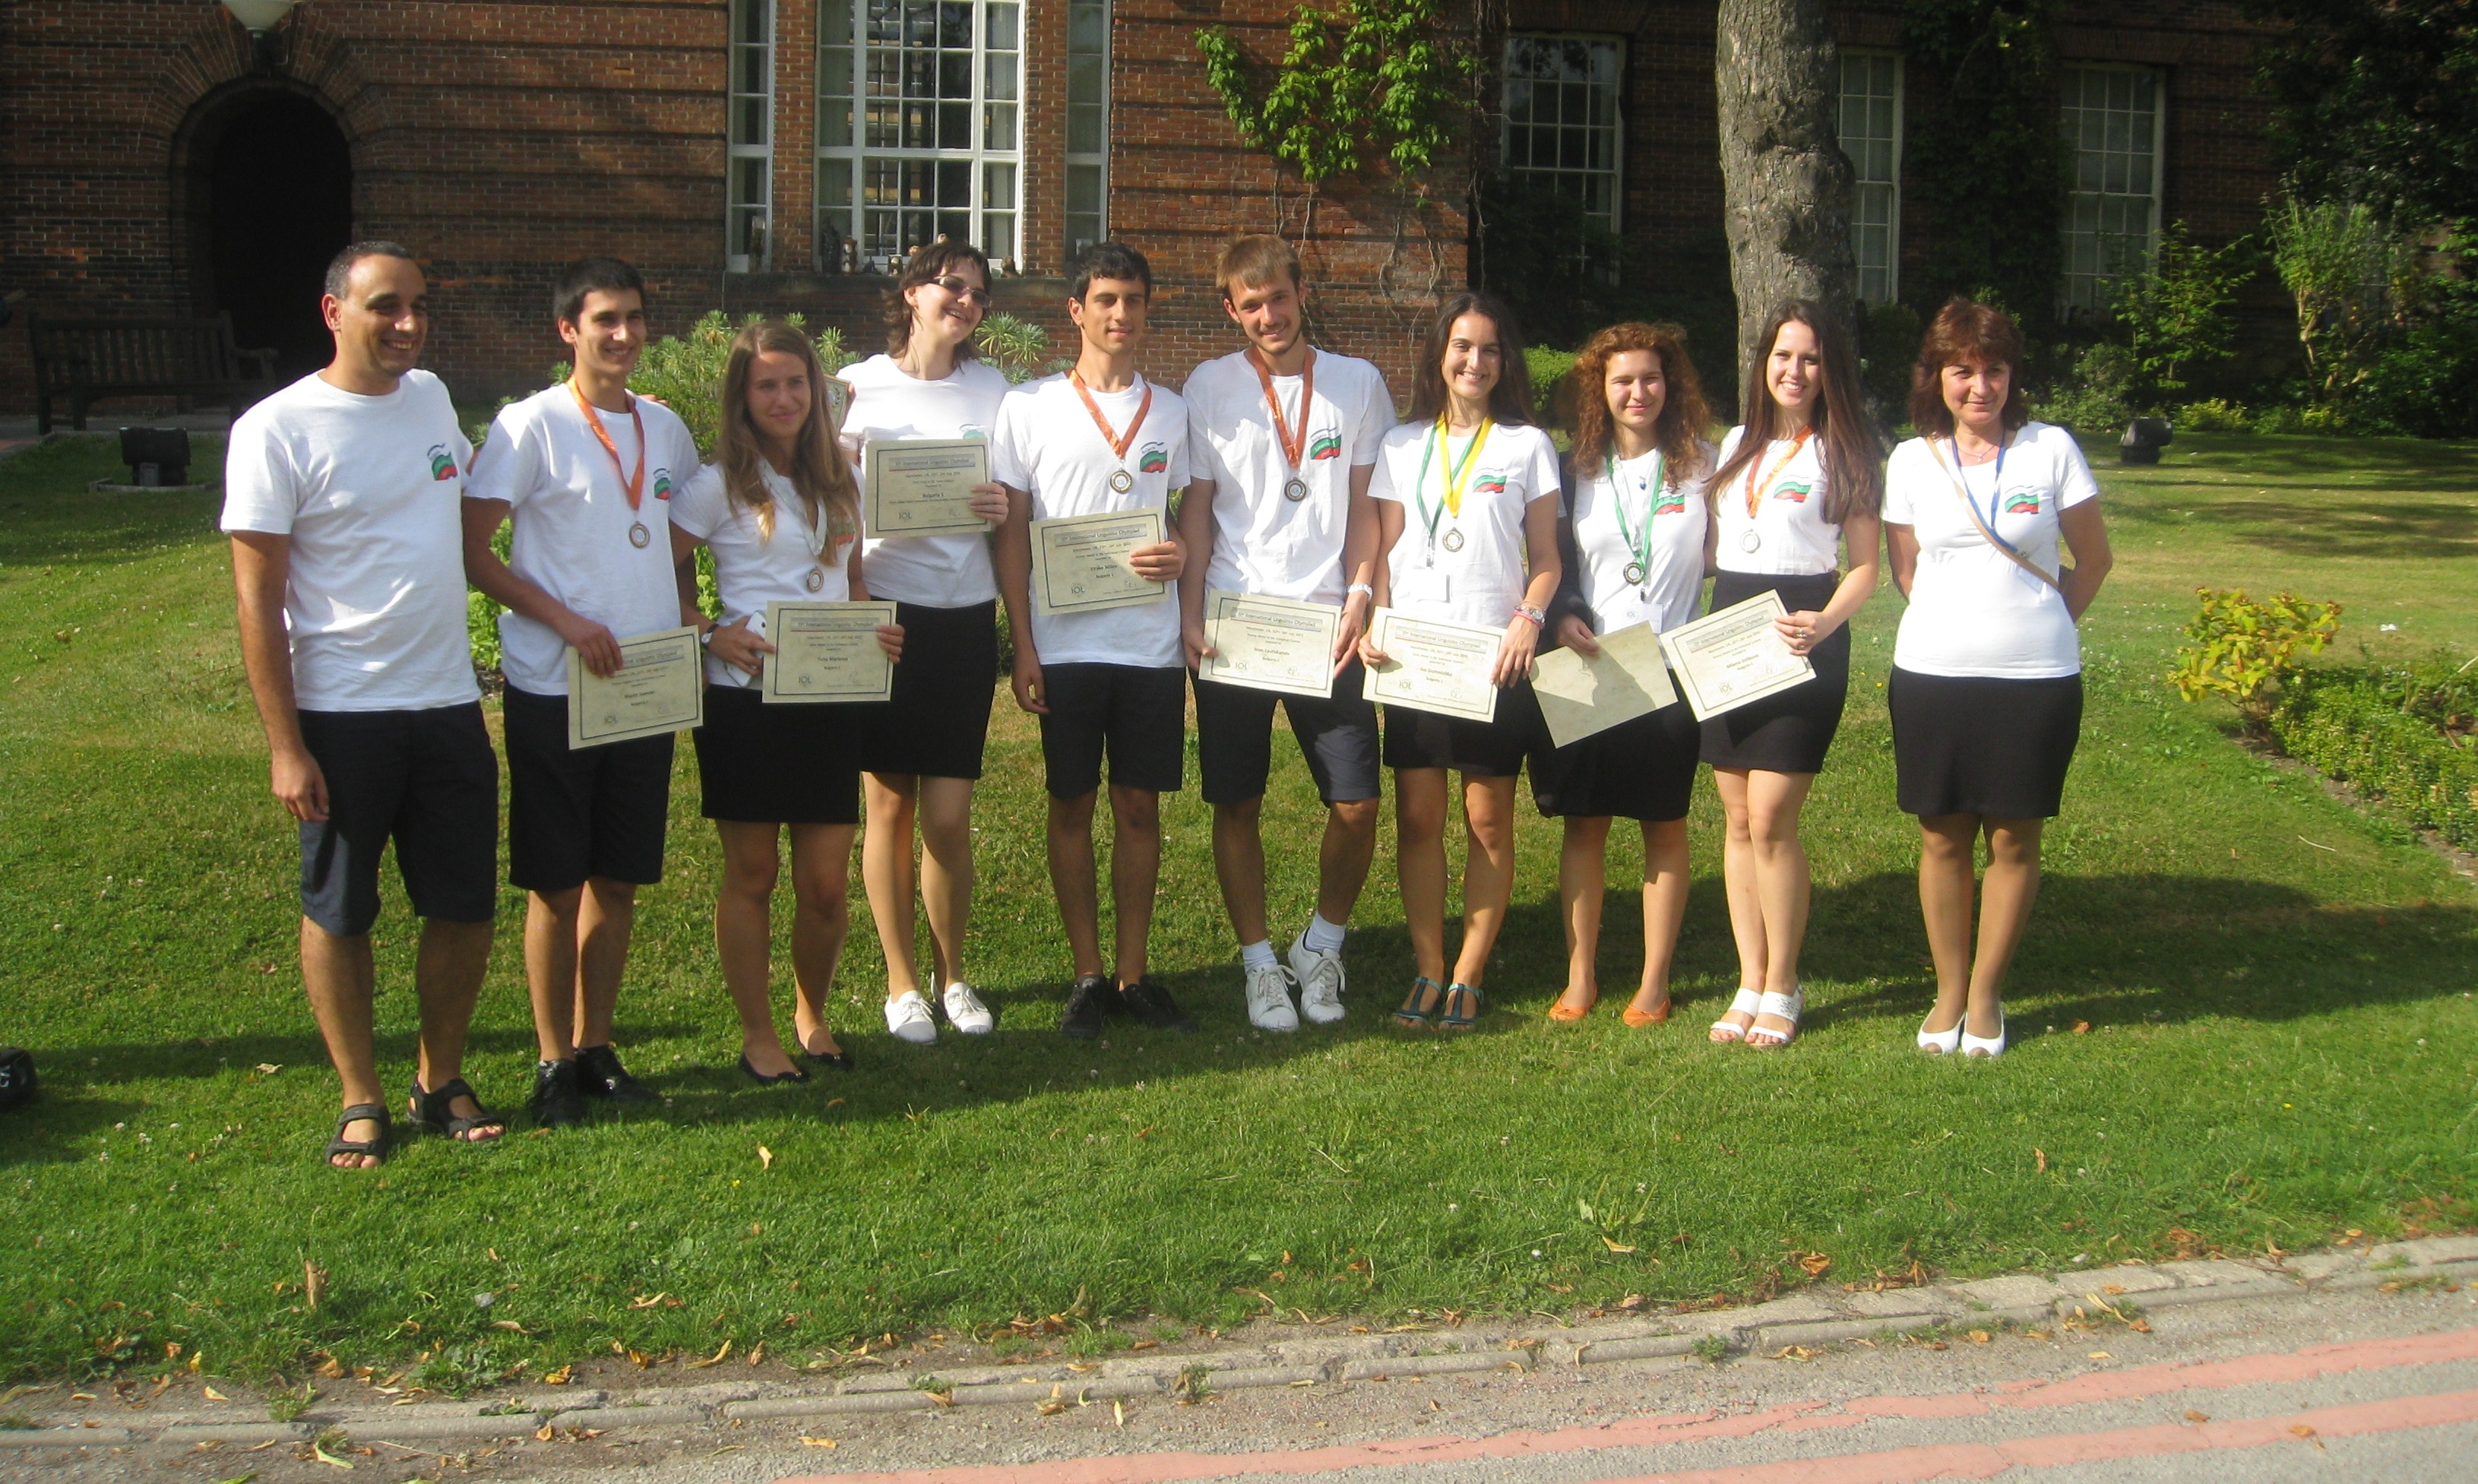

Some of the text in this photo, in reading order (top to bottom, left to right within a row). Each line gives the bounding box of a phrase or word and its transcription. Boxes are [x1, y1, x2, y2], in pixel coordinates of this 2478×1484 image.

[899, 511, 911, 520] IOL
[1071, 585, 1084, 594] IOL
[1245, 612, 1271, 622] International
[1235, 661, 1248, 670] IOL
[1398, 680, 1413, 690] IOL
[1718, 682, 1733, 693] IOL
